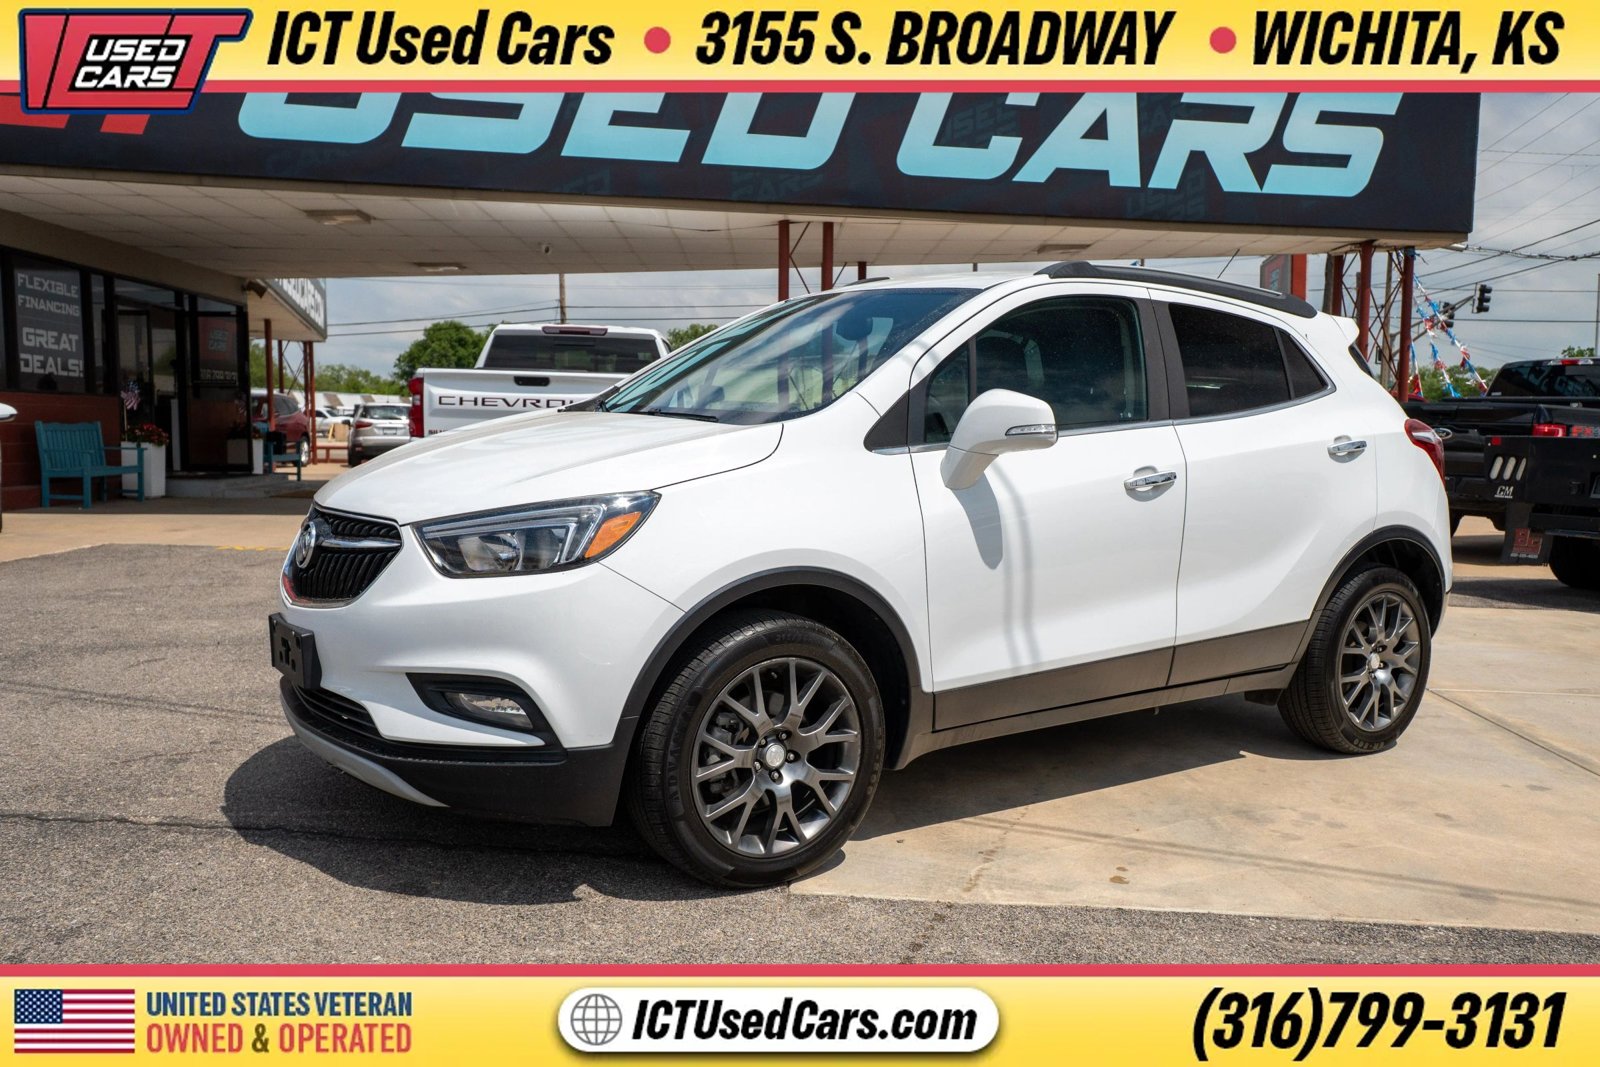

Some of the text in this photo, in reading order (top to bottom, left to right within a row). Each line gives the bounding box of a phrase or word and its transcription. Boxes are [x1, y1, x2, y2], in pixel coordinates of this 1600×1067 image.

[896, 93, 1402, 198] CARS
[17, 272, 79, 298] FLEXIBLE
[17, 294, 80, 317] FINANCING
[22, 326, 79, 352] GREAT
[20, 353, 84, 378] DEALS!
[438, 395, 574, 408] CHEVRO
